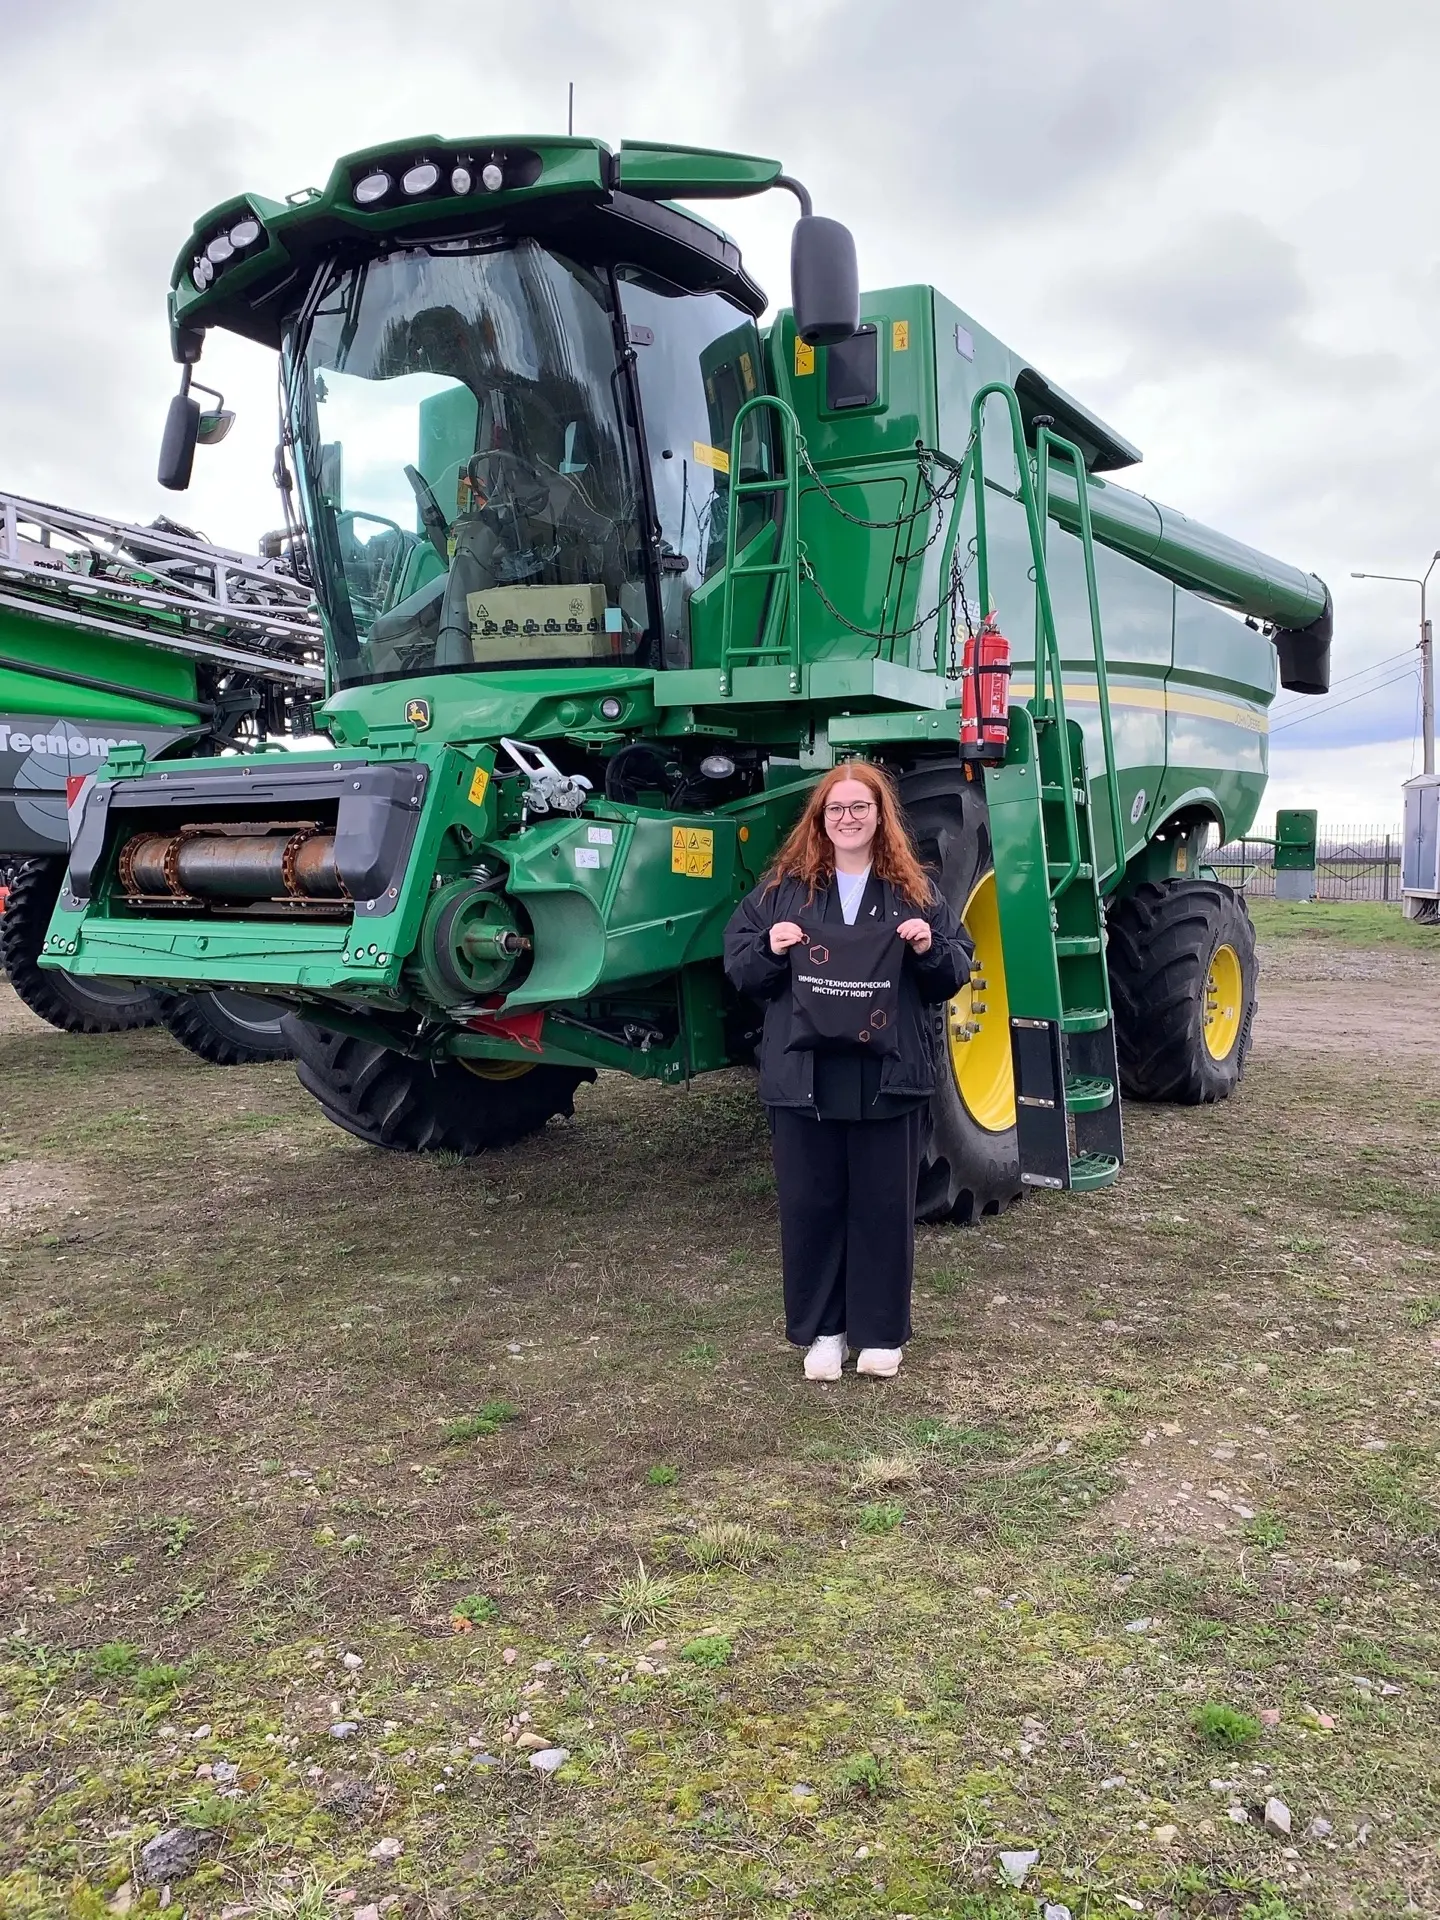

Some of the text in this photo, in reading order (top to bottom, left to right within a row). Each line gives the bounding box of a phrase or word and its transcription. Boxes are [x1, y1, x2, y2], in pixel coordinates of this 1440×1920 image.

[0, 724, 138, 757] Tecnom
[812, 985, 873, 998] ИНСТИТУТ НОВГУ
